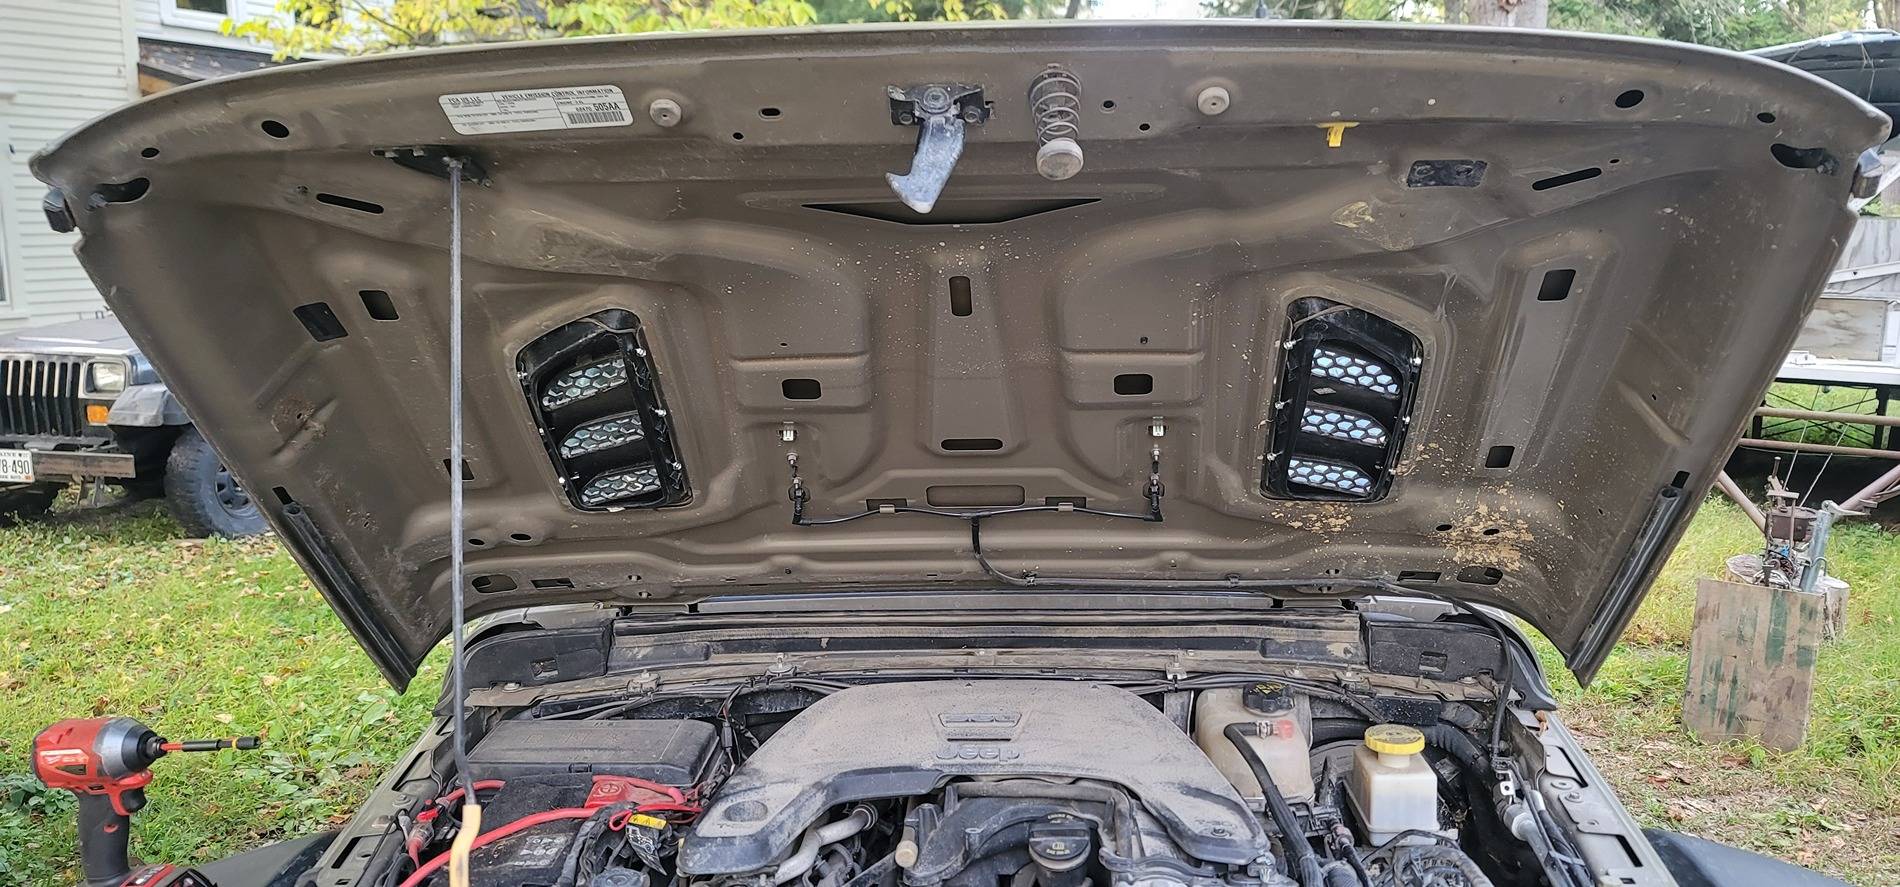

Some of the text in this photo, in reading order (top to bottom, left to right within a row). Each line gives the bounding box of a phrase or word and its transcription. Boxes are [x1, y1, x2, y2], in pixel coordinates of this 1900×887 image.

[551, 90, 575, 98] CONTROL
[576, 87, 614, 96] INFORMATION
[593, 102, 621, 111] 505AA
[0, 458, 30, 475] 8-490
[936, 743, 1021, 762] Jeep
